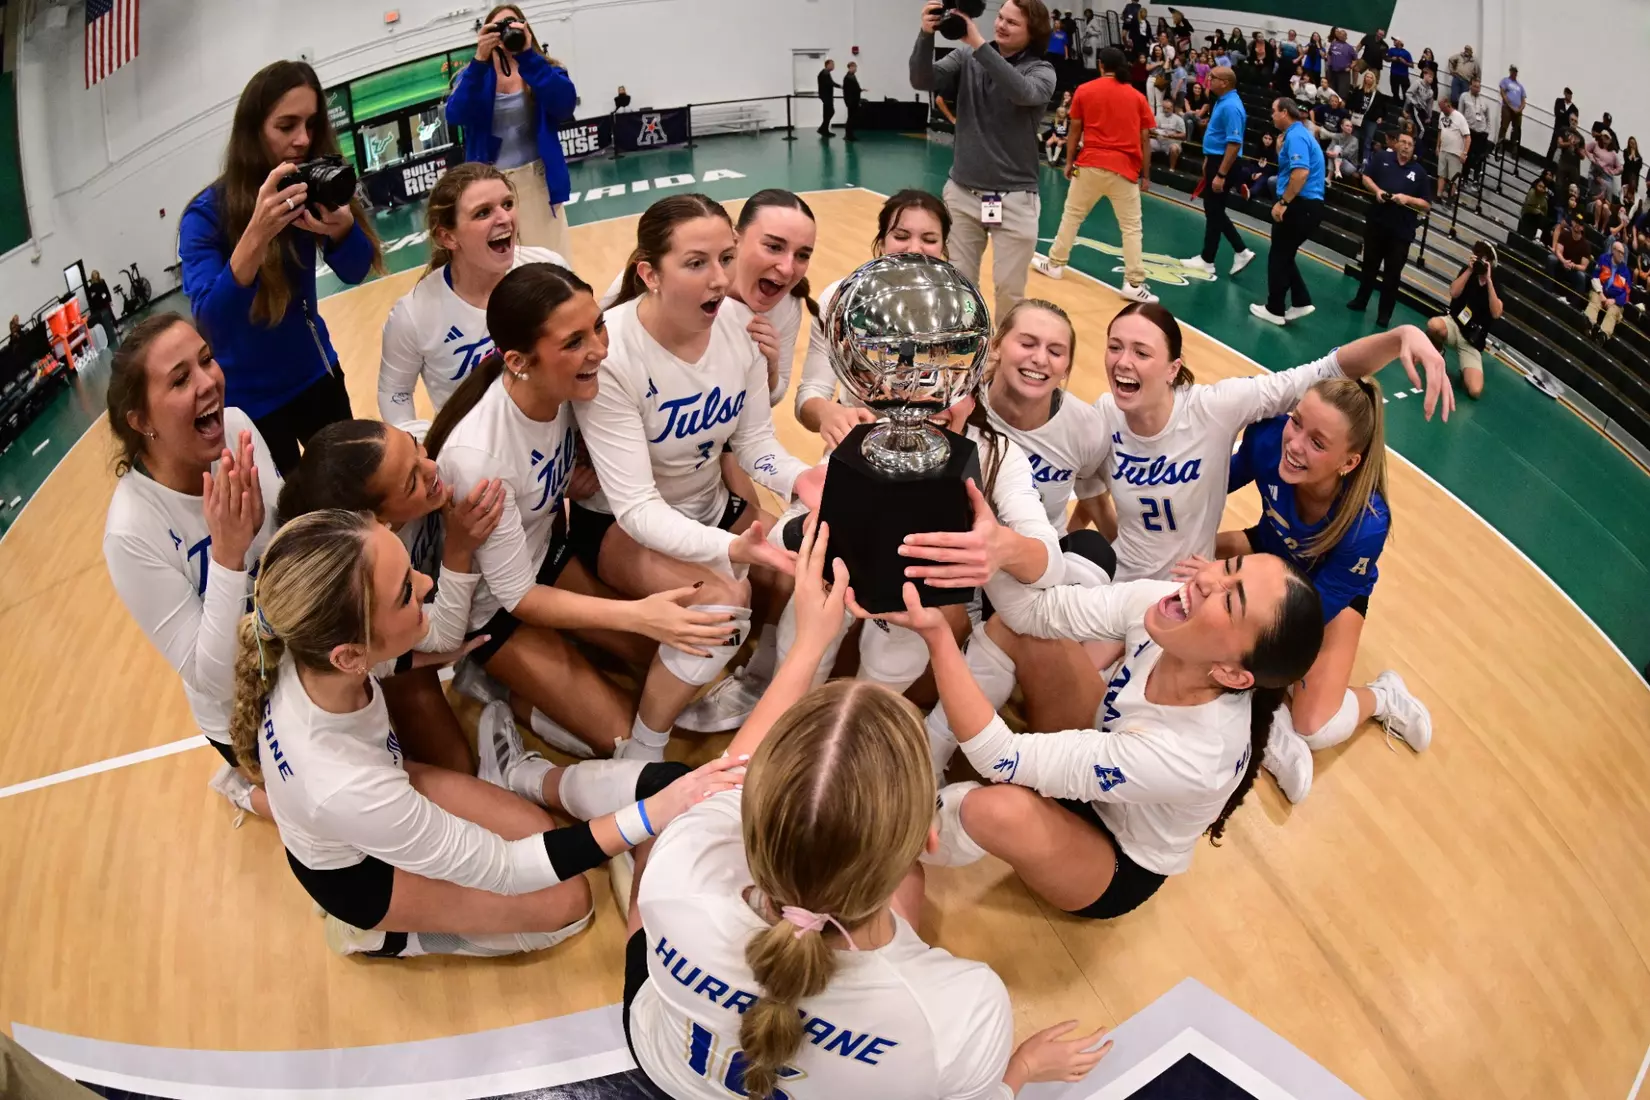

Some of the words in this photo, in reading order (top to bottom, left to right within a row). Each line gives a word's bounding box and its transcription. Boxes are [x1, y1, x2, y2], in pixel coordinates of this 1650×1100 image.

[588, 125, 598, 134] TO
[402, 160, 436, 180] BUILT
[648, 386, 747, 444] Tulsa
[1111, 451, 1203, 486] Tulsa
[1138, 496, 1177, 532] 21
[654, 937, 900, 1066] HURRANE
